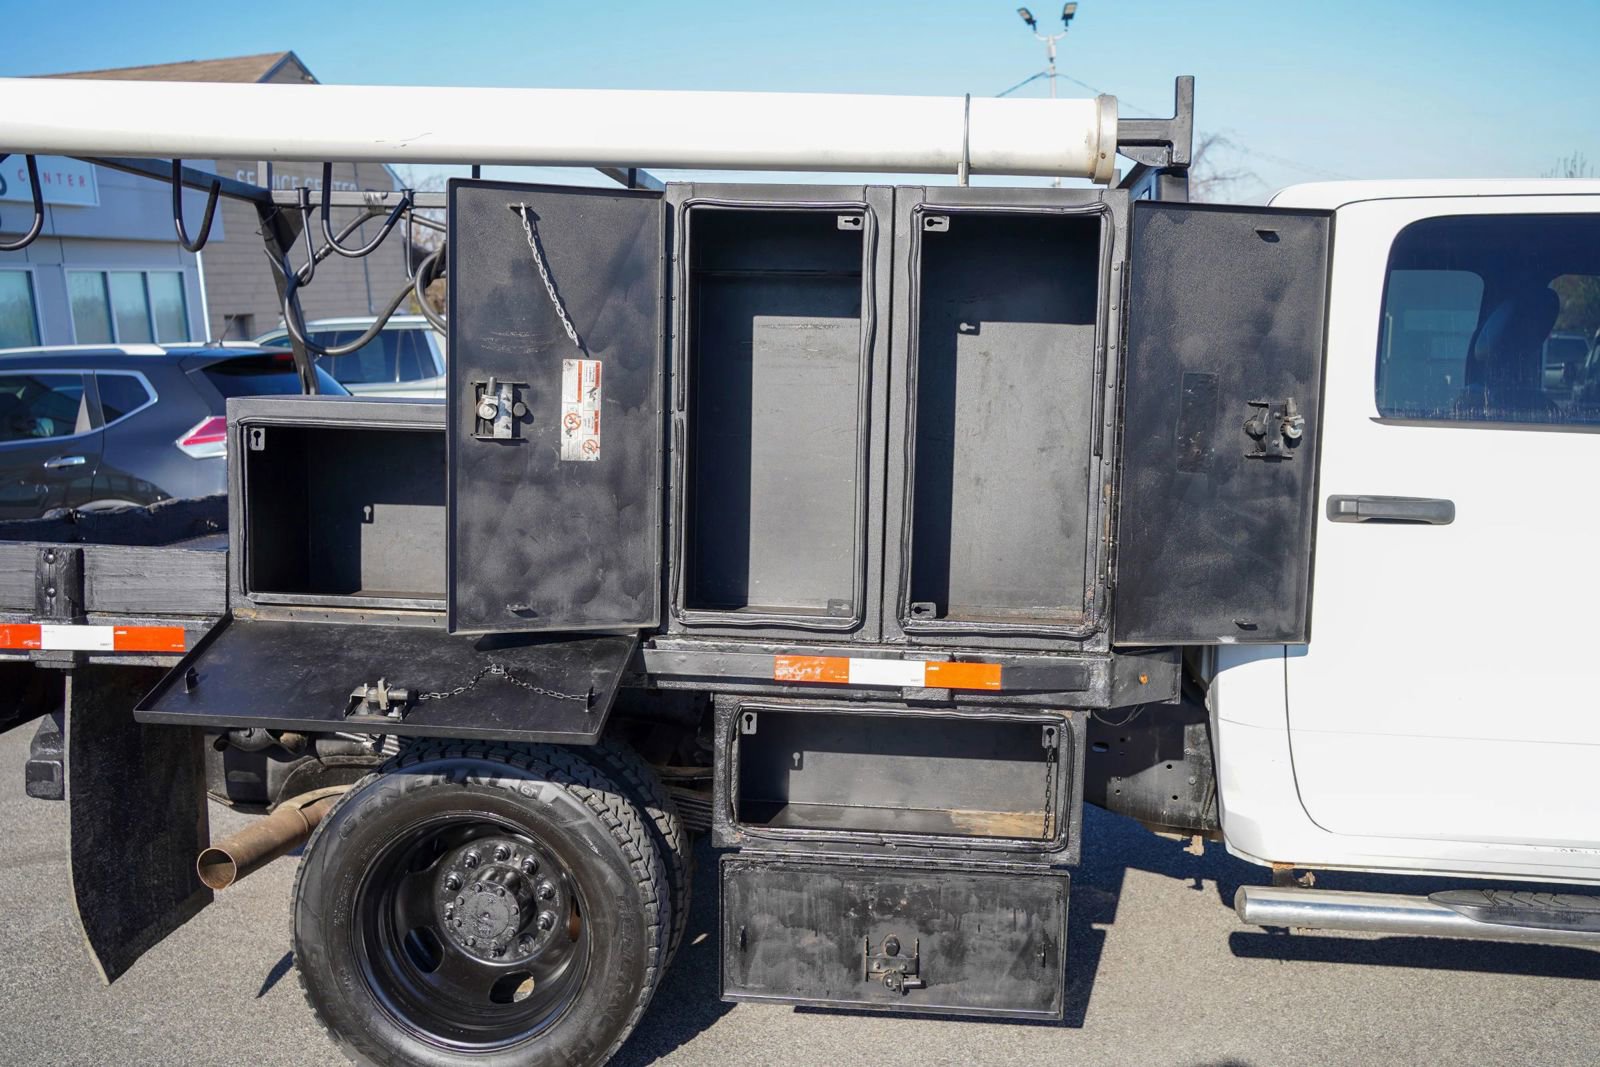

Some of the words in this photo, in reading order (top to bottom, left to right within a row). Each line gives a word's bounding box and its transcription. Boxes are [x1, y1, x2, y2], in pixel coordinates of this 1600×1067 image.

[17, 168, 86, 187] CNTER
[236, 169, 299, 190] SEICE
[304, 177, 358, 191] CETER
